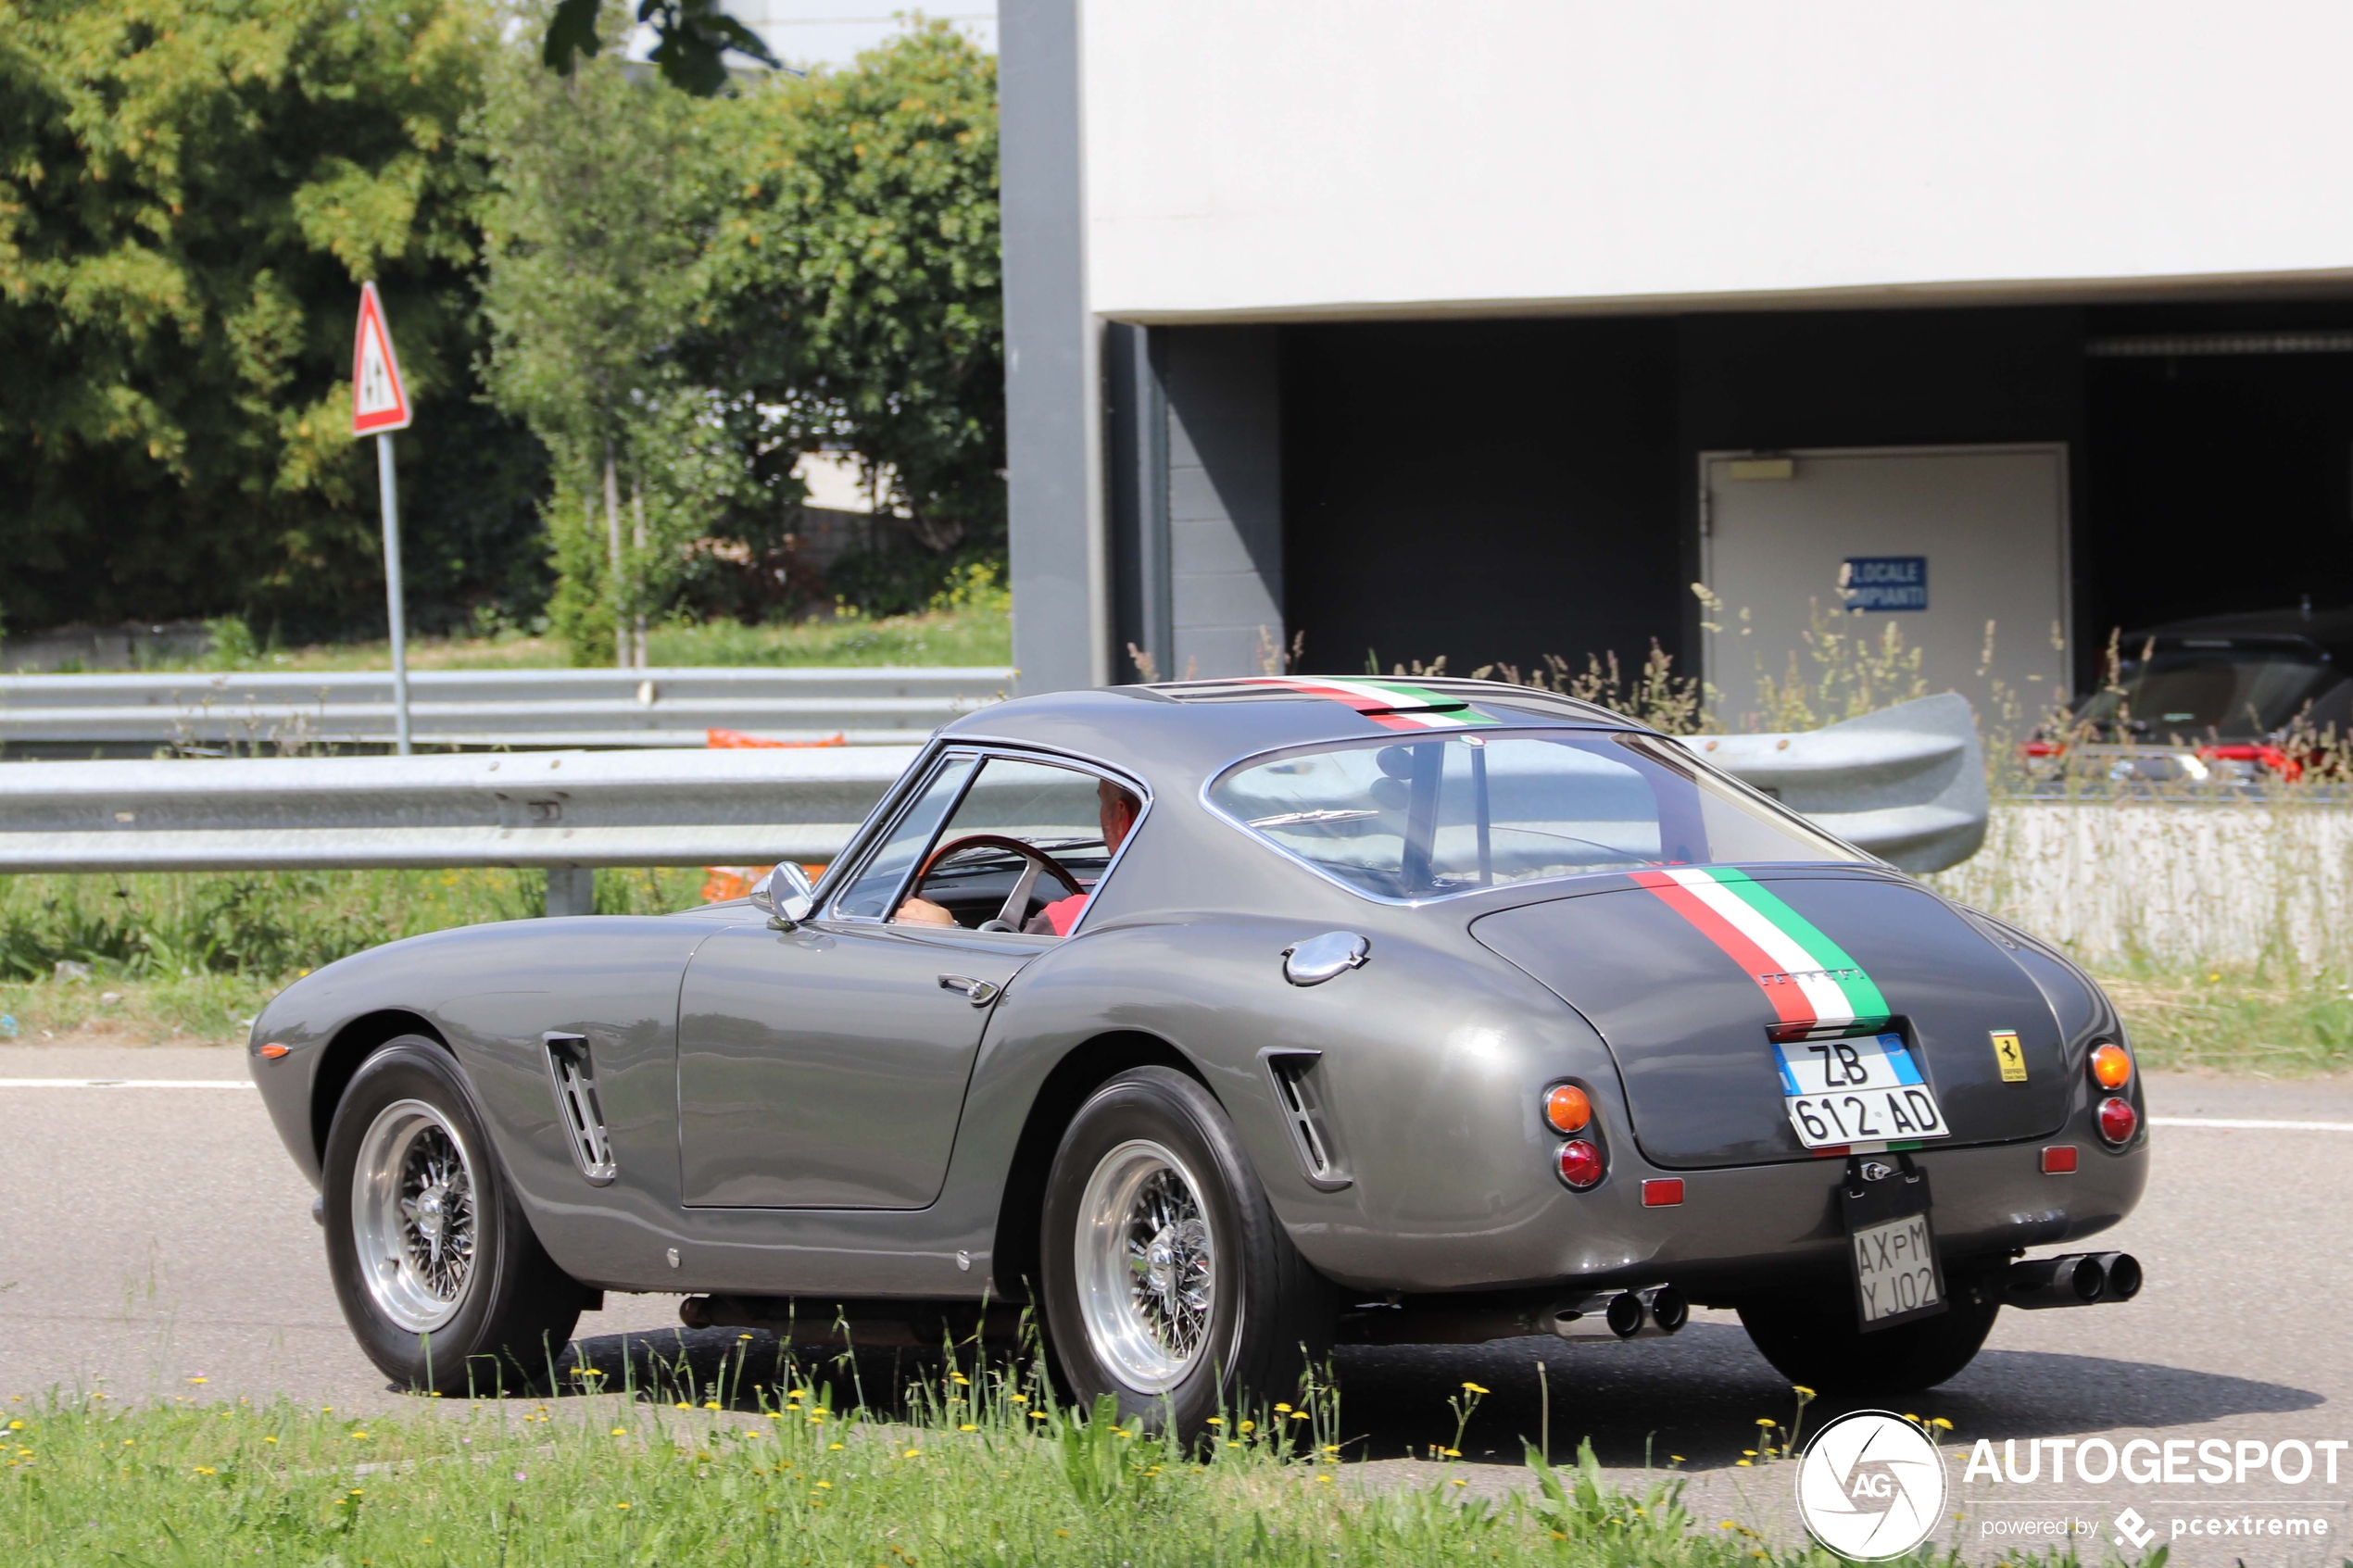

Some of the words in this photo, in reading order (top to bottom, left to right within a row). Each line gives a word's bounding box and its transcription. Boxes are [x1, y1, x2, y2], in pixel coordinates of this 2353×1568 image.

[1853, 561, 1918, 583] LOCALE
[1807, 1043, 1869, 1087] ZB
[1795, 1096, 1881, 1140] 612
[1886, 1089, 1939, 1134] AD
